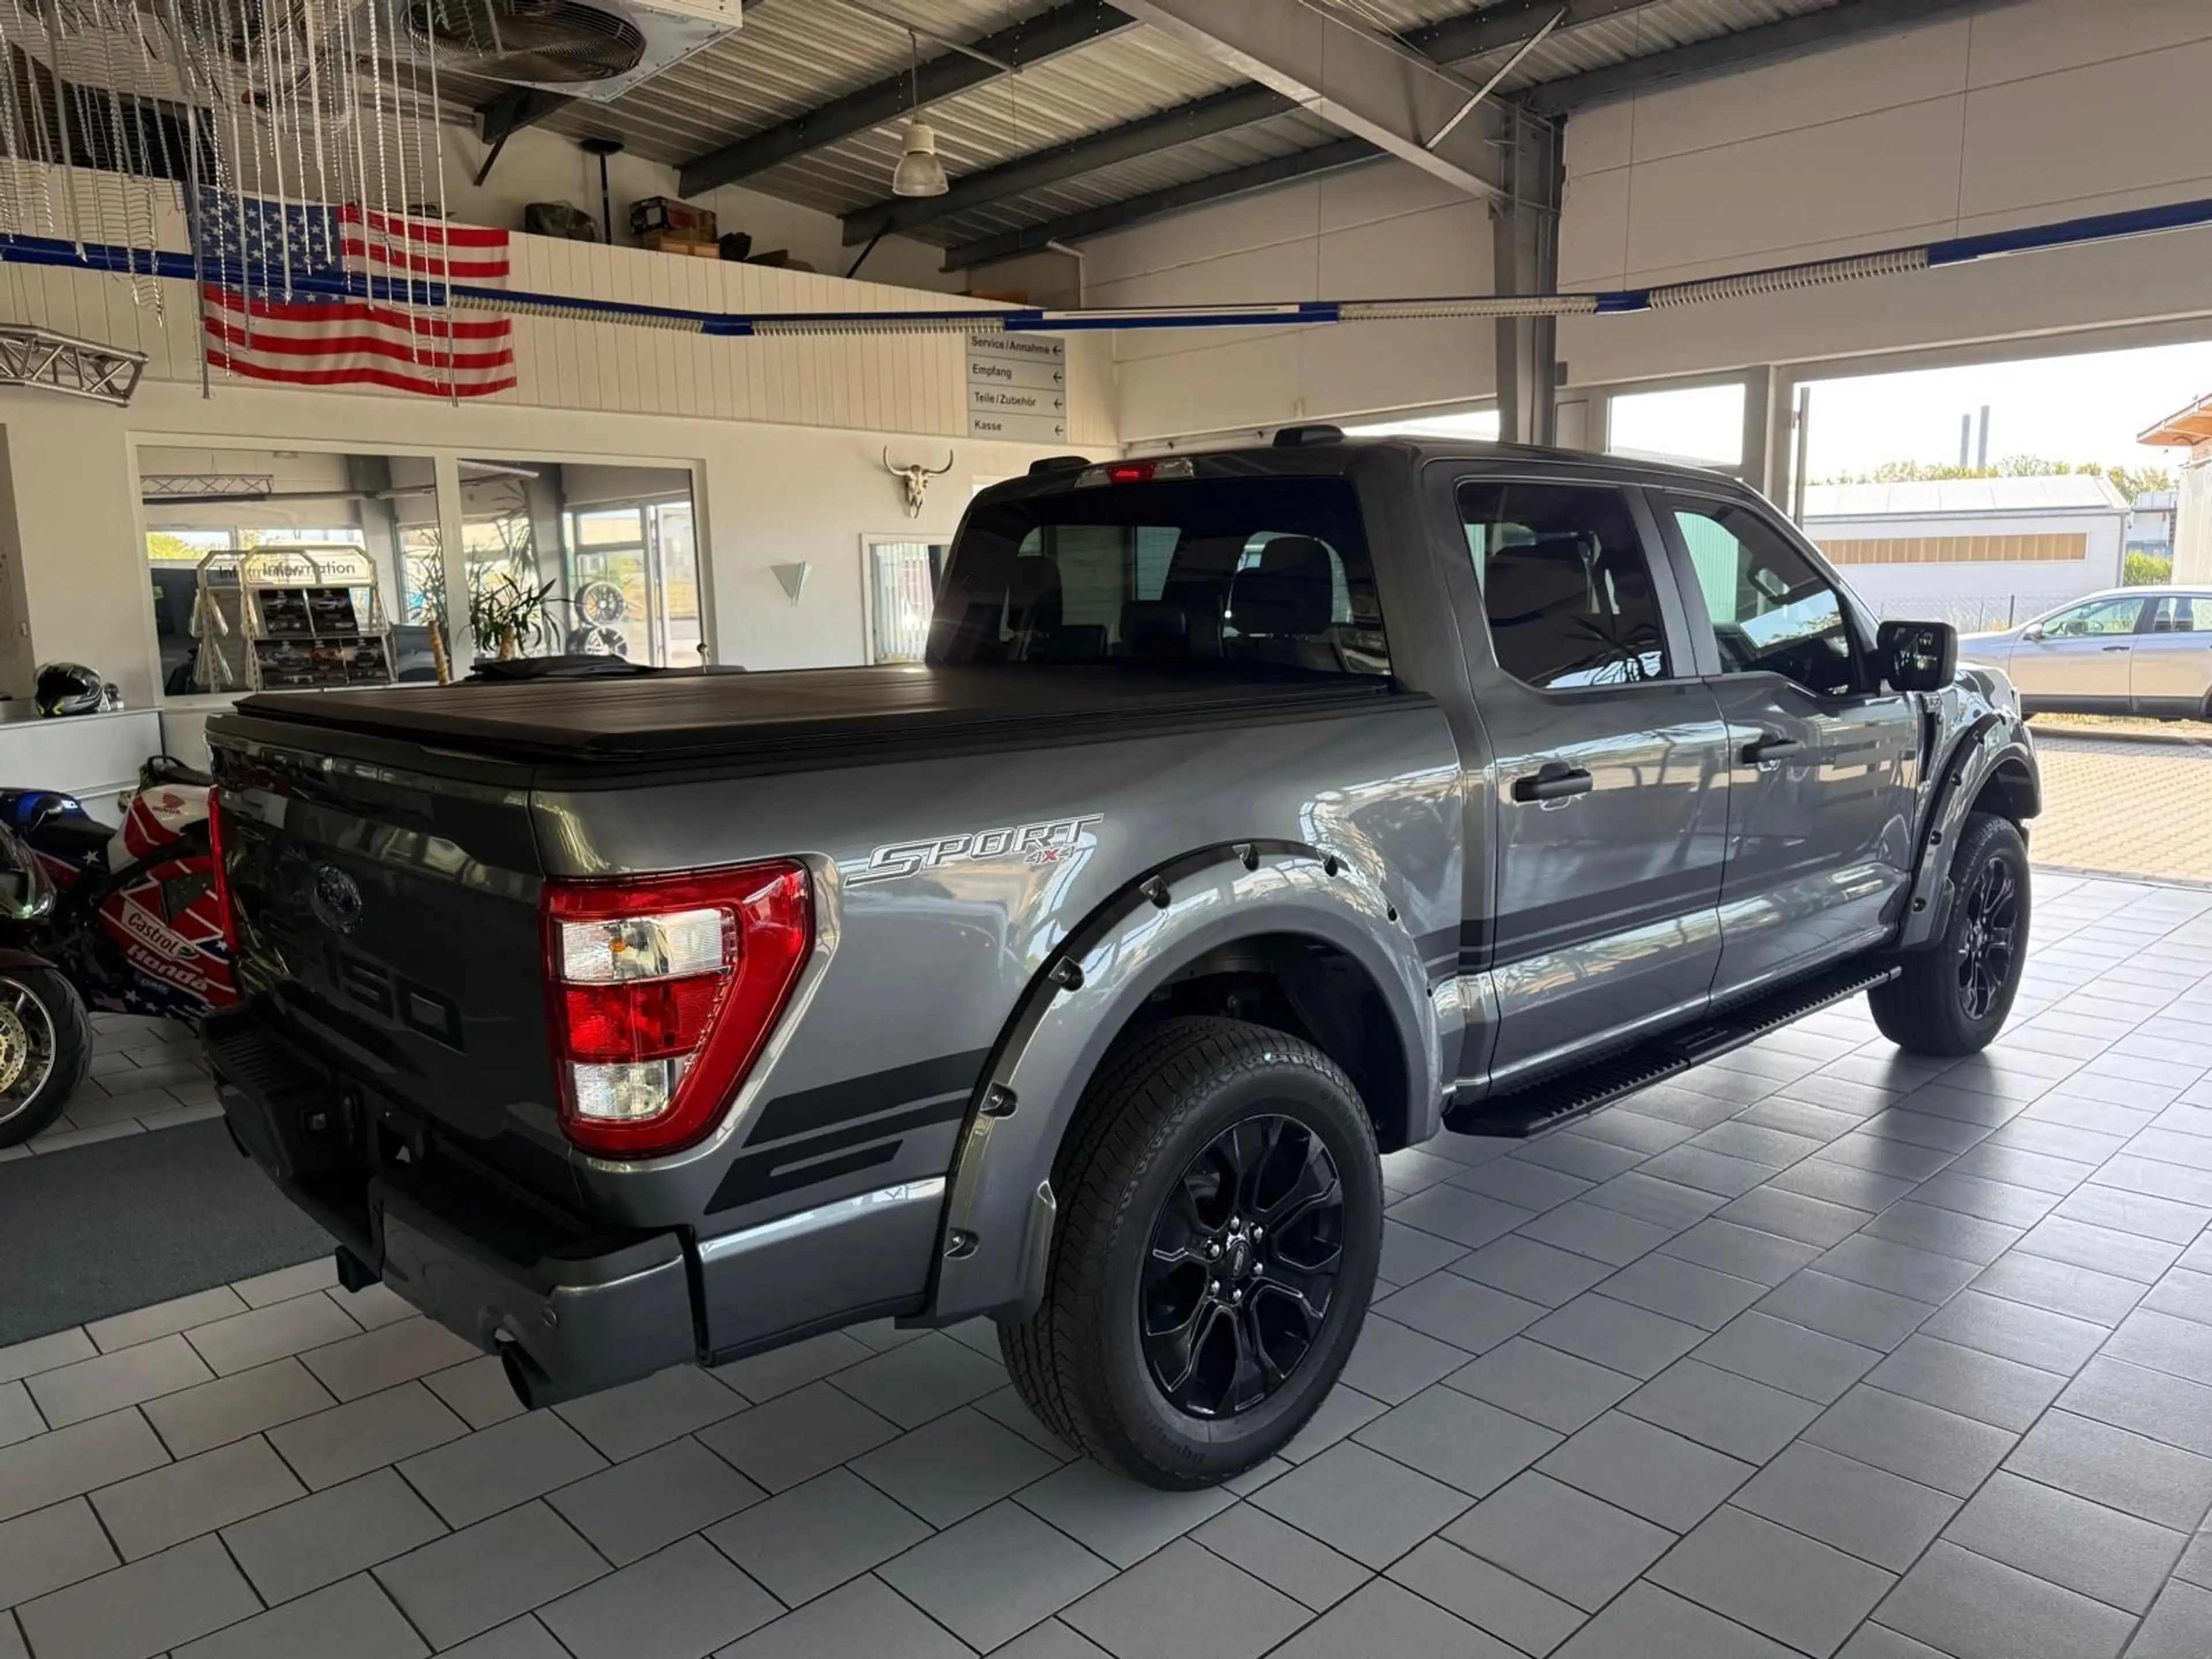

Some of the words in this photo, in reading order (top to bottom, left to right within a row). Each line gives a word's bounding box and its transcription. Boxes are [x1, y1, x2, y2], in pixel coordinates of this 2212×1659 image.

[972, 363, 1012, 380] Empfang
[975, 420, 1002, 431] Kasse
[844, 813, 1103, 888] SPORT
[128, 912, 180, 953] Castrol
[126, 944, 208, 993] Honda
